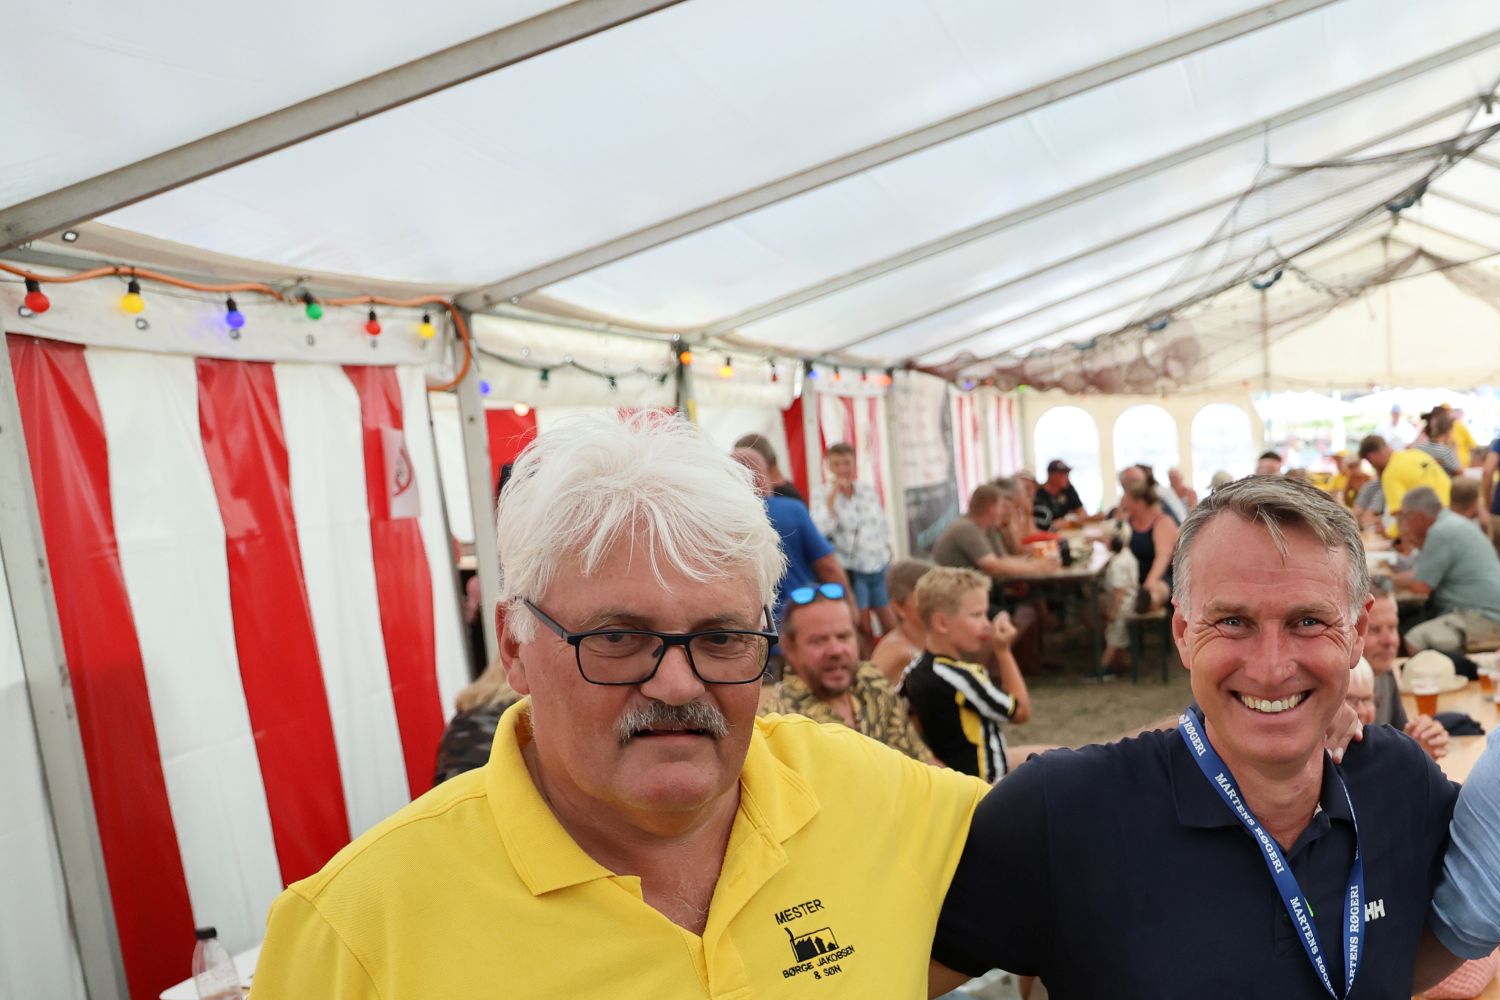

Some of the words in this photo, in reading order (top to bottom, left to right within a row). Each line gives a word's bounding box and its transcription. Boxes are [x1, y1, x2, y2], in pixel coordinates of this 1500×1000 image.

[1214, 772, 1256, 826] MARTENS
[1254, 827, 1285, 874] RØGERI
[774, 898, 825, 925] MESTER
[1289, 896, 1319, 955] MARTENS
[1349, 885, 1360, 933] RØGERI
[1363, 898, 1386, 922] HH
[782, 962, 814, 979] BØRGE
[816, 944, 856, 966] JAKOBSEN
[813, 970, 822, 980] &
[823, 964, 842, 977] SØN
